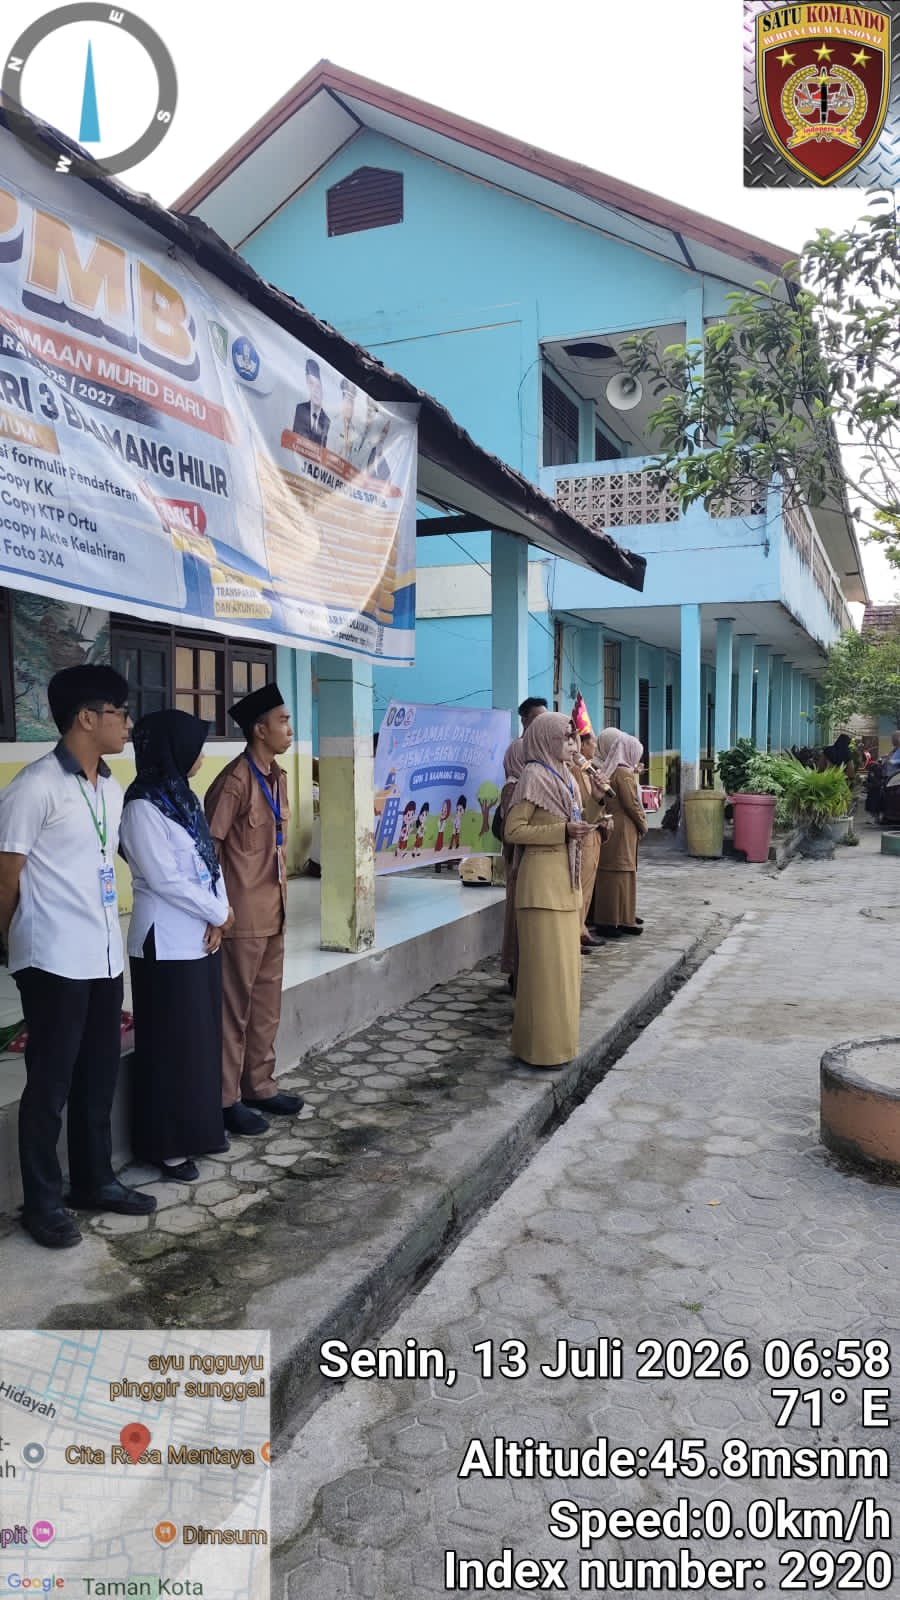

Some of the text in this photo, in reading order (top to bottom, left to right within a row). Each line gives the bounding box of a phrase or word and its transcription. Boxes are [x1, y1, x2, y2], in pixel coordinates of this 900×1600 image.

[79, 383, 115, 407] 2027
[97, 356, 159, 396] MURID
[163, 387, 206, 419] BARU
[39, 382, 59, 420] 3
[178, 451, 229, 497] HILIR
[12, 447, 67, 477] formulir
[69, 467, 138, 501] Pendaftaran
[34, 478, 54, 497] KK
[301, 461, 335, 489] JADWAL
[1, 489, 97, 532] Copy KTP Ortu
[3, 538, 65, 569] Foto 3X4
[40, 525, 68, 547] Akte
[70, 535, 126, 563] Kelahiran
[453, 726, 489, 746] DATAN
